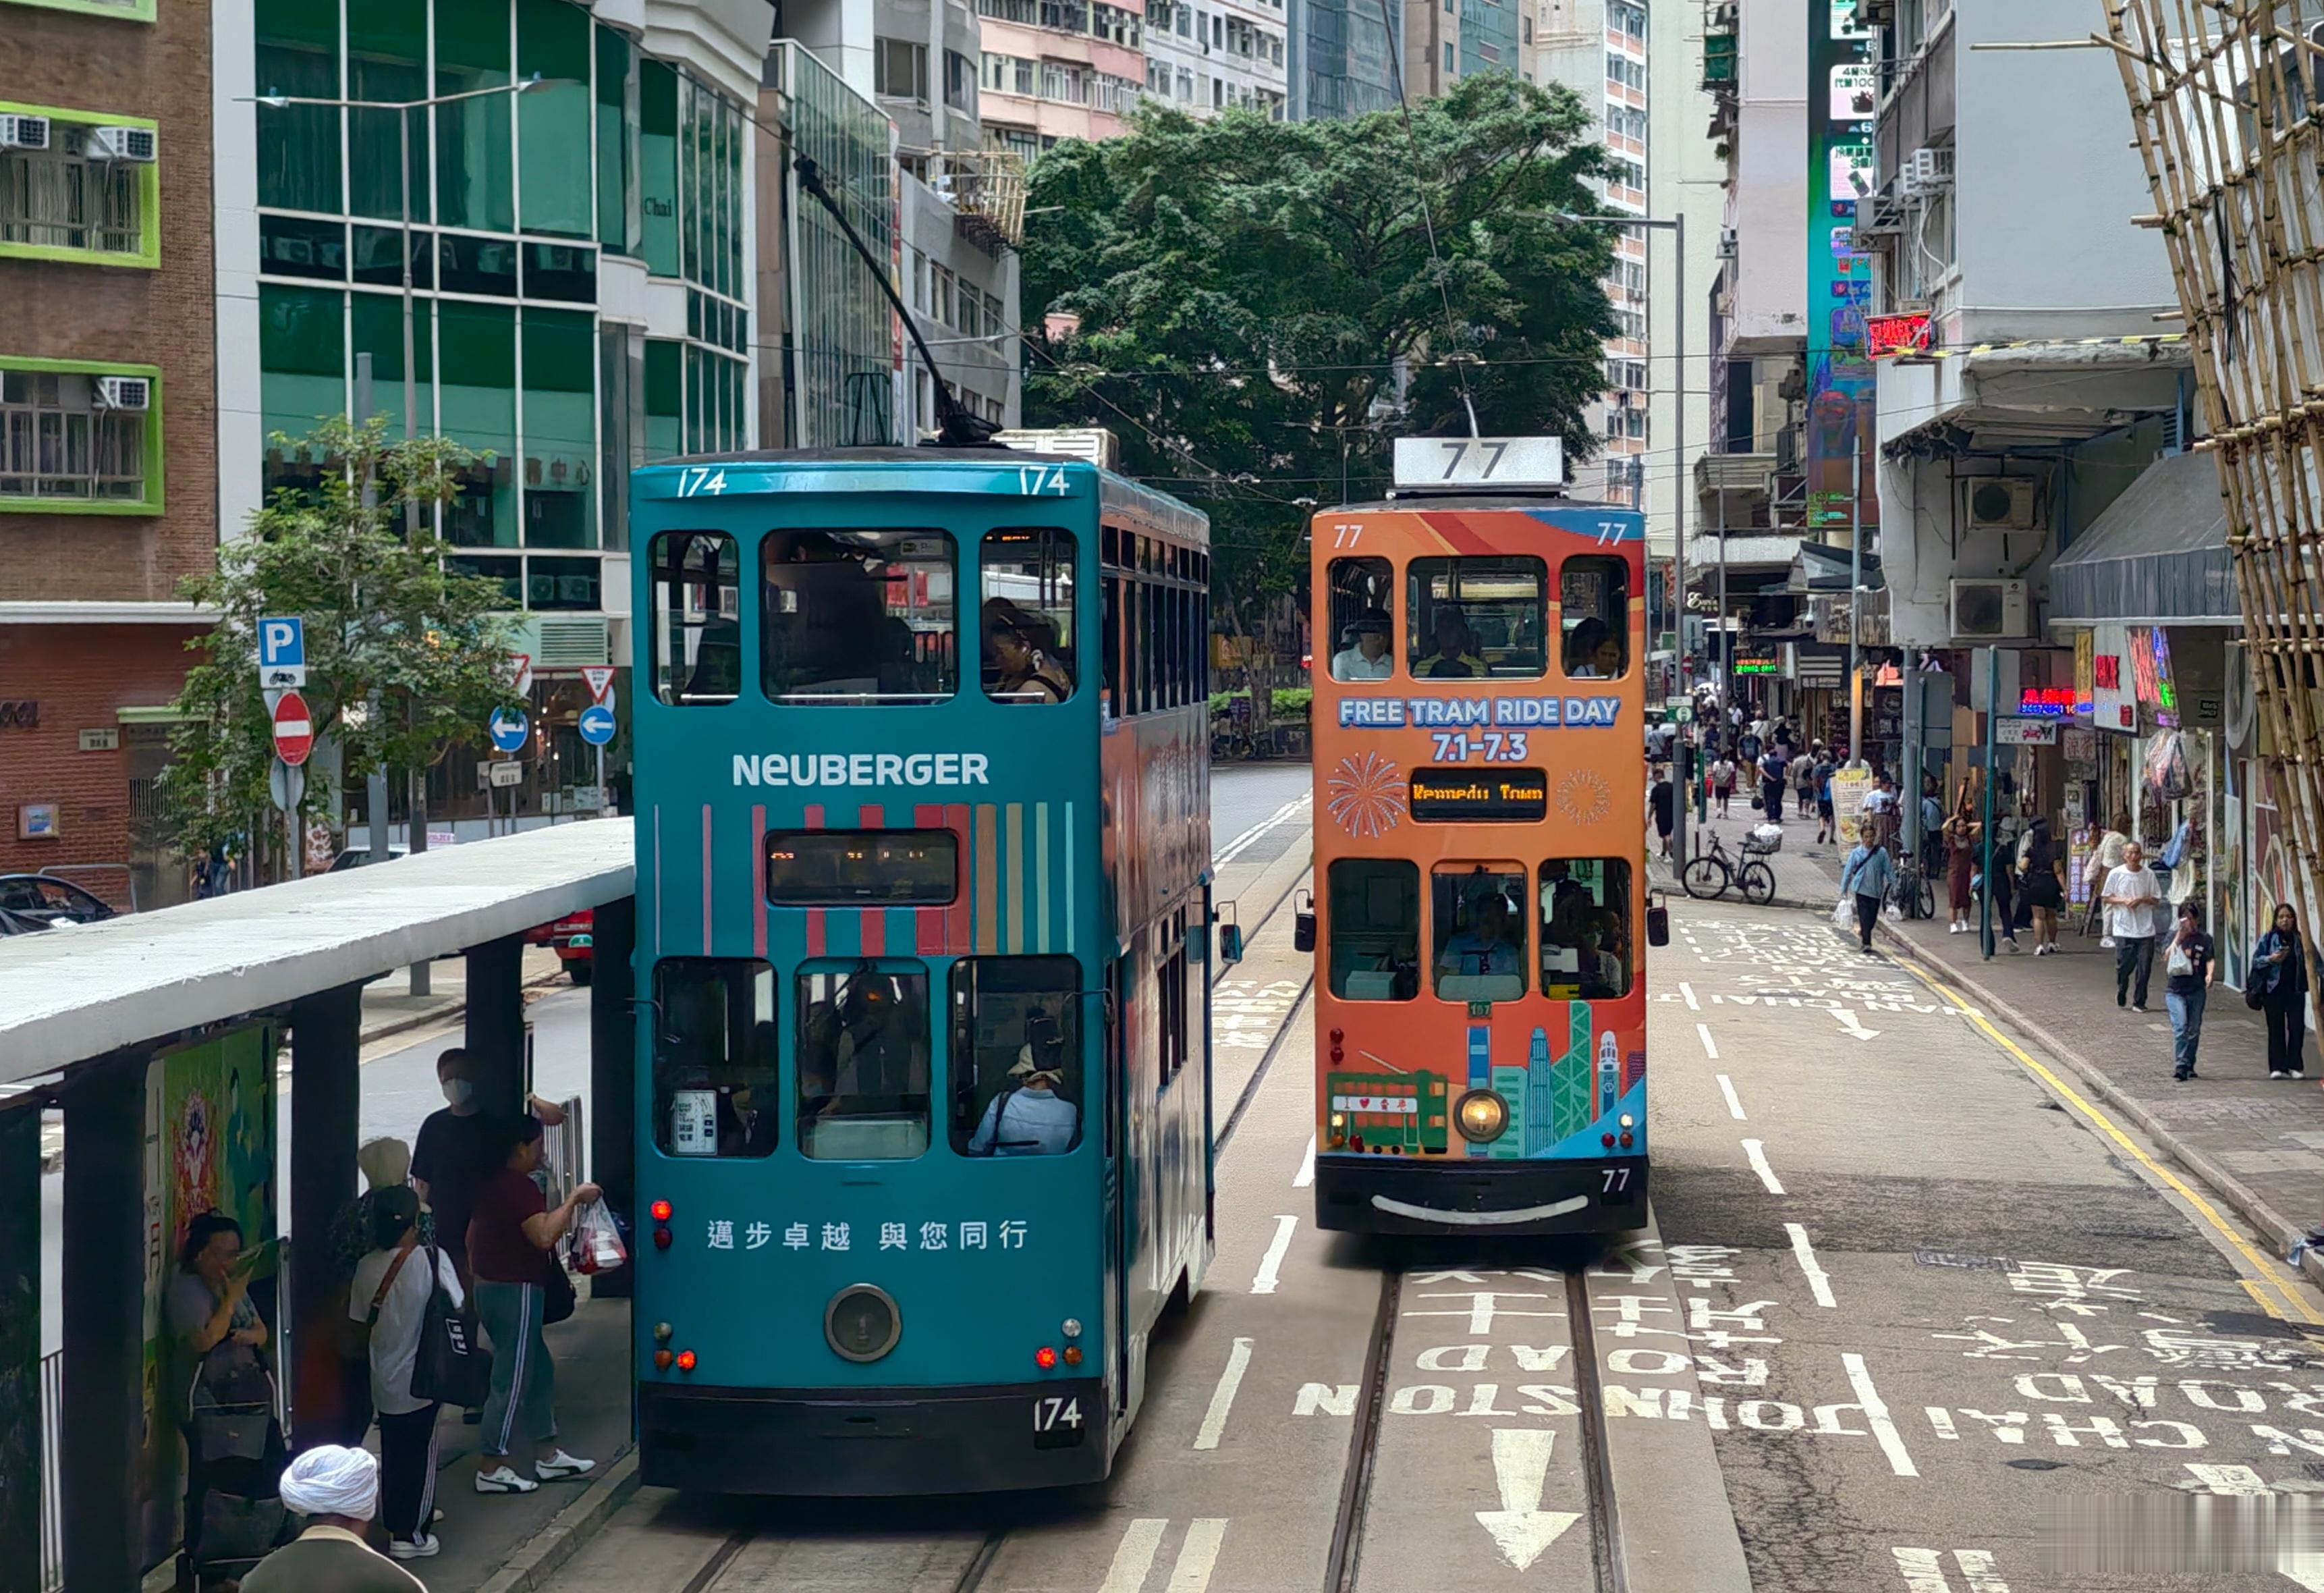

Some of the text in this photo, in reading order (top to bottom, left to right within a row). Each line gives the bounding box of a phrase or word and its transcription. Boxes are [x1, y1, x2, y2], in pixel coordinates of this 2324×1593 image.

[1441, 442, 1508, 479] 77
[677, 468, 727, 497] 174
[1020, 466, 1070, 495] 174
[1333, 524, 1363, 548] 77
[1597, 522, 1627, 547] 77
[267, 622, 294, 663] P
[1339, 697, 1621, 726] FREE TRAM RIDE DAY
[1431, 732, 1528, 762] 7.1-7.3
[1709, 994, 1843, 1009] CHAI
[1602, 1168, 1630, 1193] 77
[707, 1218, 1029, 1252] 邁步卓越 與您同行
[1416, 1344, 1771, 1386] ROAD
[1034, 1397, 1082, 1432] 174
[1292, 1382, 1870, 1437] JOHNSTON
[1924, 1406, 2210, 1449] CHAI
